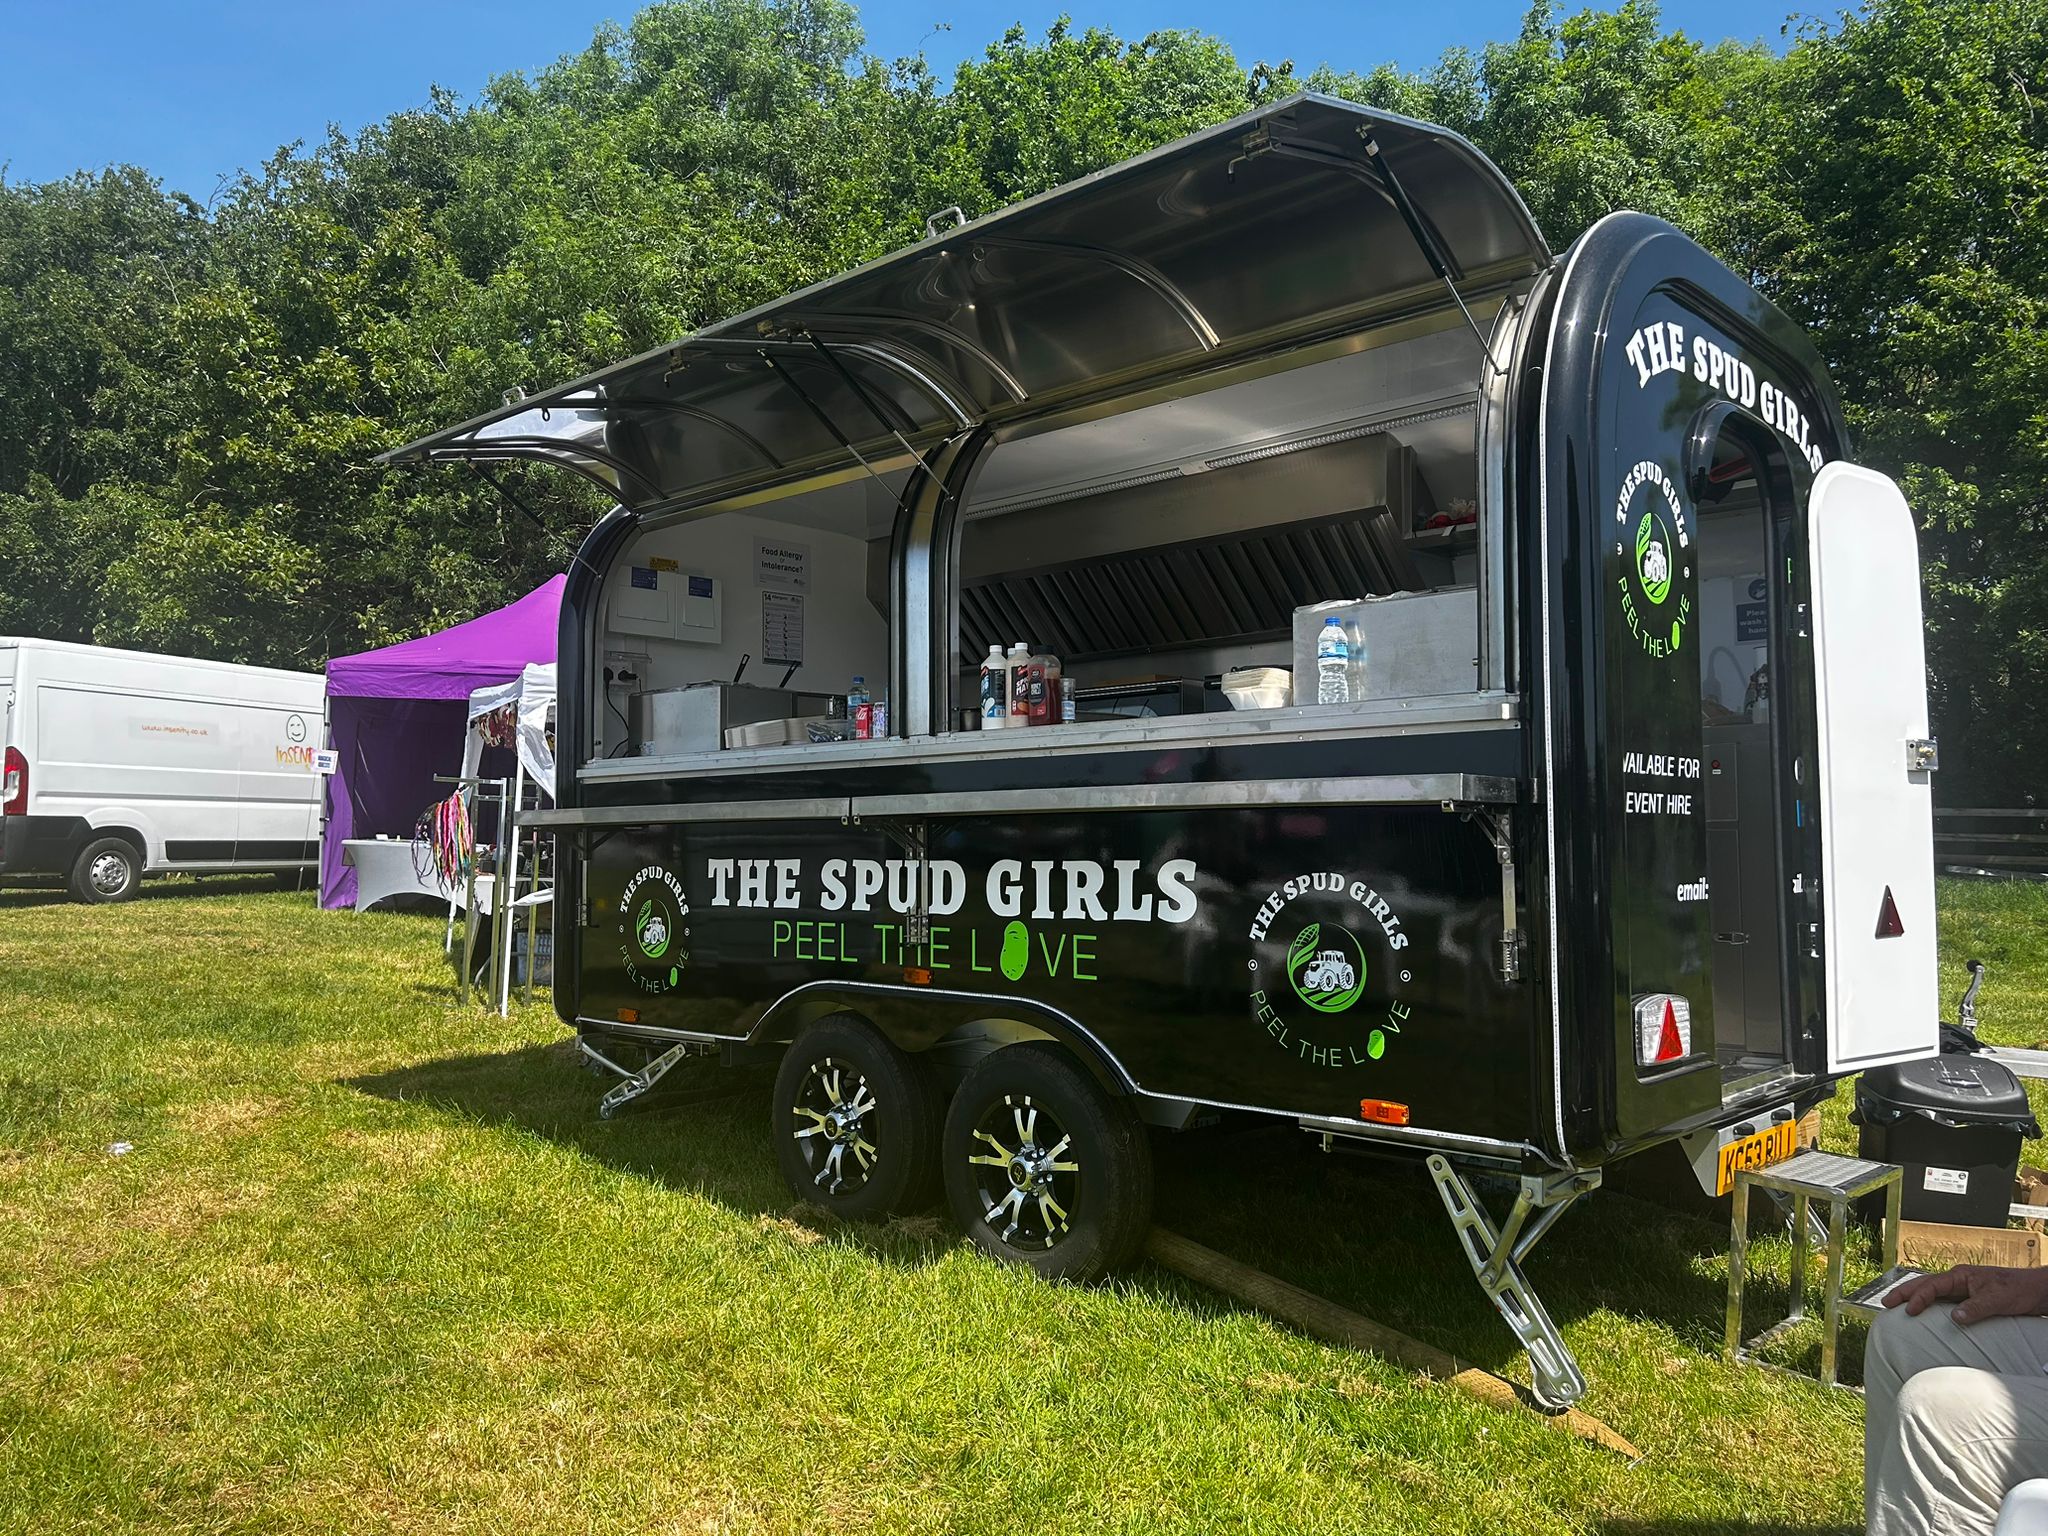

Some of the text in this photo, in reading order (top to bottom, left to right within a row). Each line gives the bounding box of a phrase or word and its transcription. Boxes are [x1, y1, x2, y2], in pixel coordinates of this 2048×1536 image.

[1625, 321, 1824, 474] THE SPUD GIRLS
[1616, 460, 1689, 548] THE SPUD GIRLS
[761, 546, 803, 562] Food Allergy
[761, 560, 804, 574] Intolerance?
[1618, 576, 1639, 640] PEEL
[1642, 629, 1664, 659] THE
[1623, 752, 1700, 779] VAILABLE FOR
[1626, 792, 1692, 815] EVENT HIRE
[620, 865, 690, 916] THE SPUD GIRLS
[708, 858, 1198, 922] THE SPUD GIRLS
[1249, 872, 1409, 951] THE SPUD GIRLS
[1677, 876, 1709, 902] email:
[619, 944, 637, 983] PEEL
[640, 975, 660, 994] THE
[773, 920, 858, 963] PEEL
[874, 924, 951, 970] THE
[1250, 989, 1289, 1049] PEEL
[1299, 1038, 1343, 1067] THE
